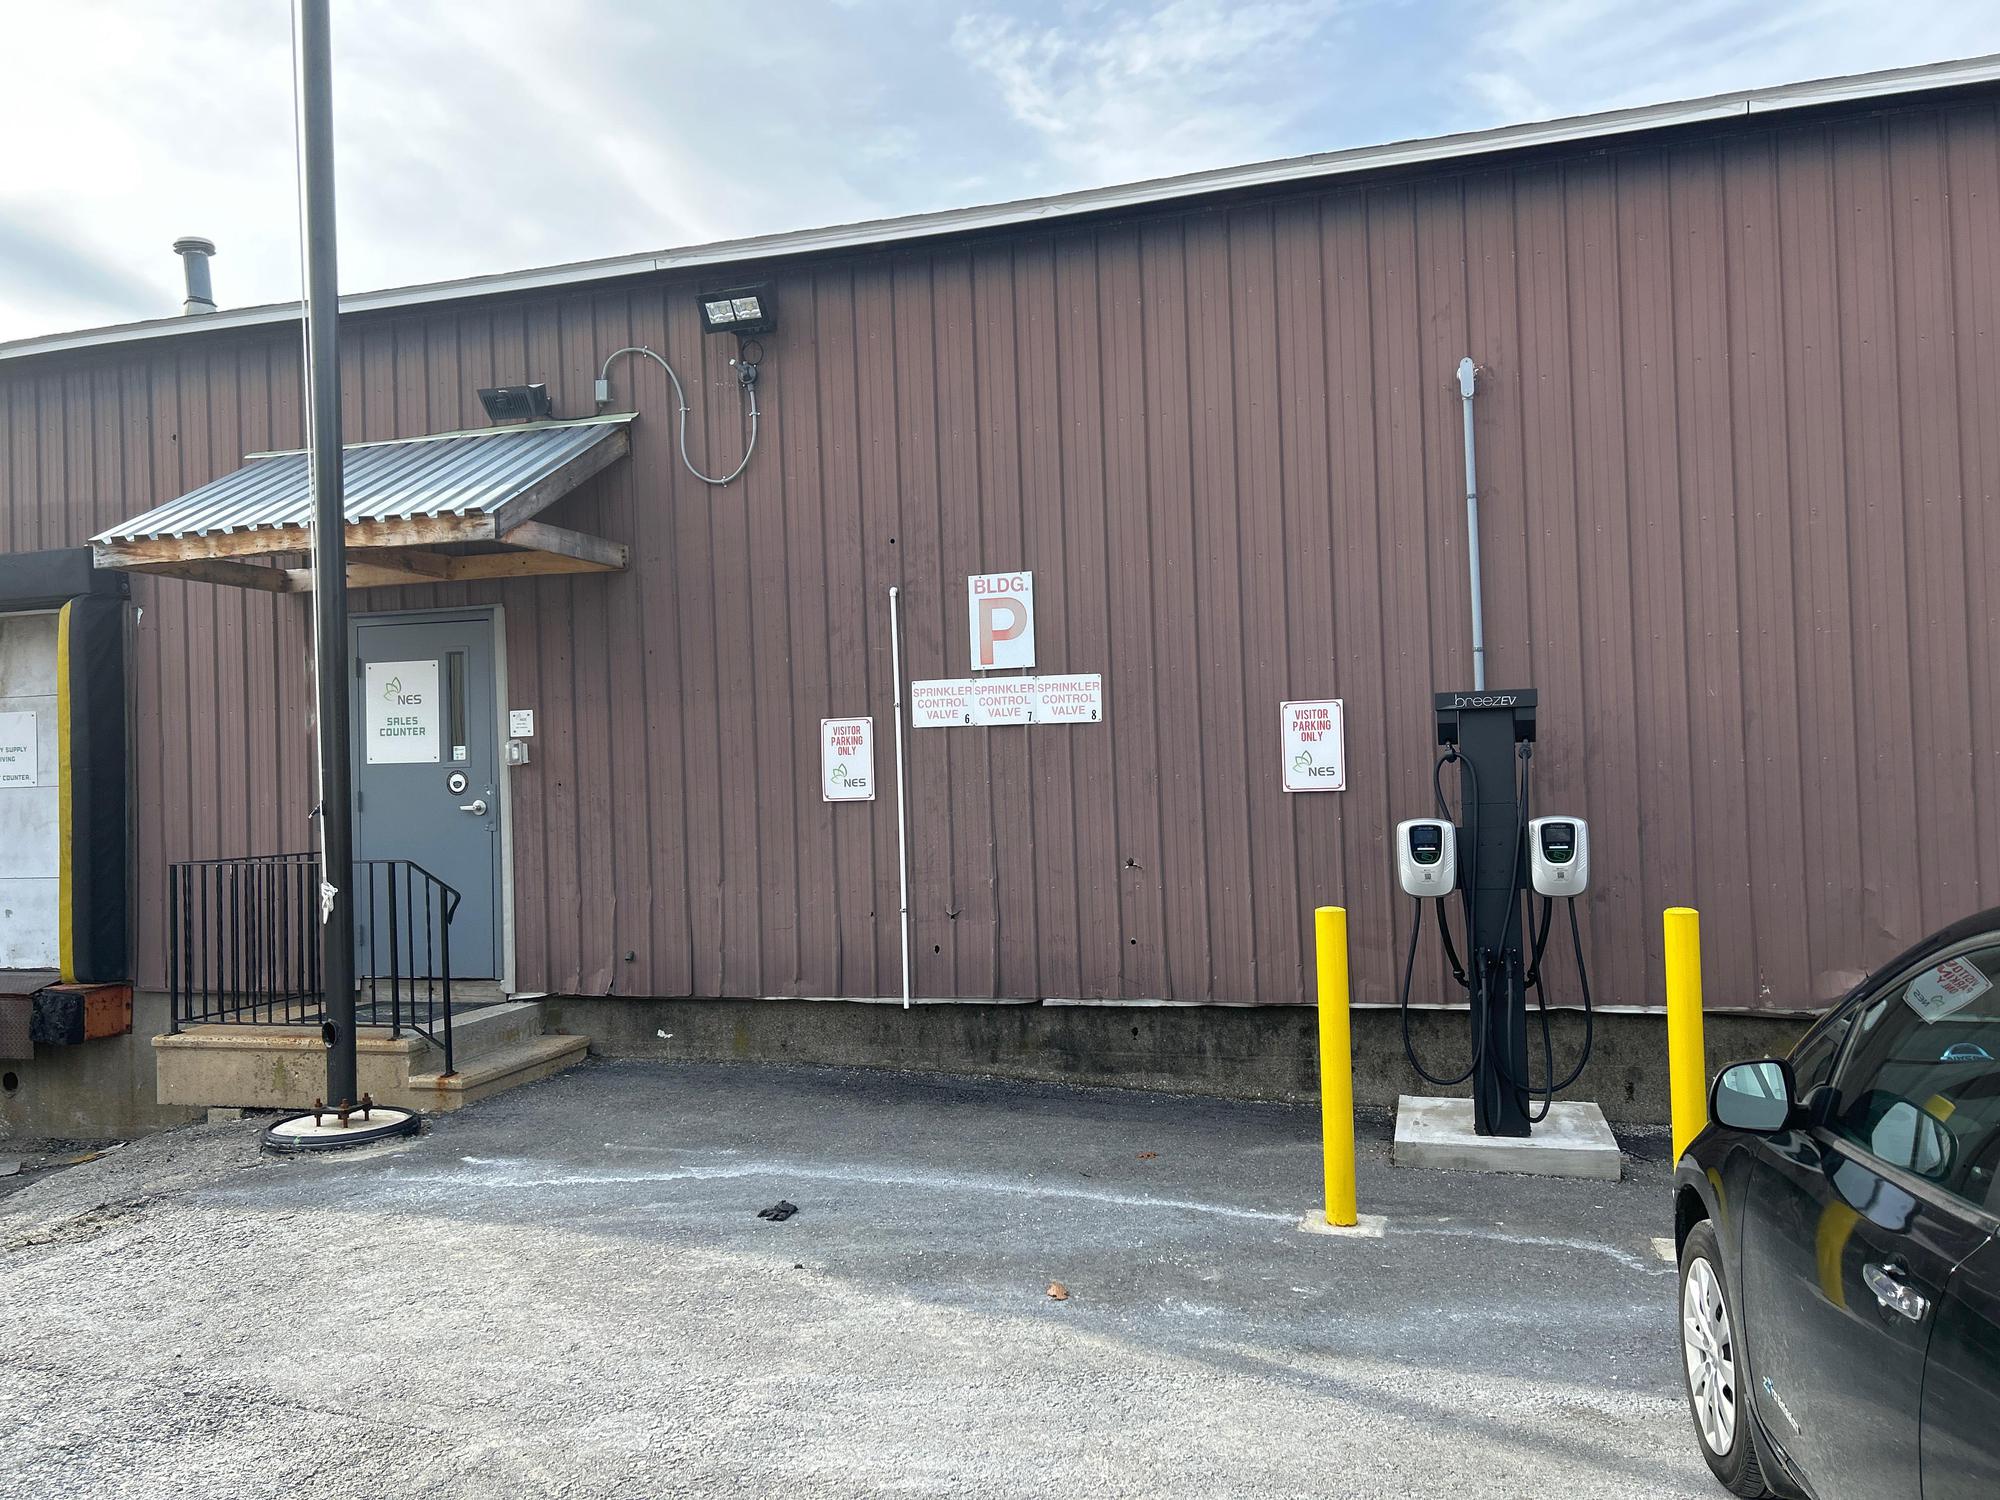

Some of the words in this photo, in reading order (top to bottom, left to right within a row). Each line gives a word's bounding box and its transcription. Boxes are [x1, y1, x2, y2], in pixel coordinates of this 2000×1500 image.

[974, 576, 1029, 594] BLDG.
[979, 597, 1028, 665] P
[913, 686, 972, 697] SPRINKLER
[974, 683, 1035, 695] SPRINKLER
[1037, 681, 1100, 693] SPRINKLER
[397, 694, 422, 705] NES
[917, 698, 968, 709] CONTROL
[979, 696, 1031, 706] CONTROL
[1042, 694, 1096, 704] CONTROL
[1454, 693, 1517, 708] breezEV
[926, 709, 959, 720] VALVE
[964, 713, 970, 724] 6
[988, 707, 1021, 718] VALVE
[1027, 711, 1033, 722] 7
[1051, 705, 1086, 716] VALVE
[1091, 710, 1097, 720] 8
[1295, 708, 1329, 720] VISITOR
[387, 716, 418, 726] SALES
[1292, 720, 1332, 731] PARKING
[379, 727, 426, 737] COUNTER
[833, 725, 861, 736] VISITOR
[831, 736, 864, 746] PARKING
[1301, 731, 1323, 742] ONLY
[837, 746, 857, 756] ONLY
[1308, 766, 1336, 777] NES
[843, 778, 867, 788] NES
